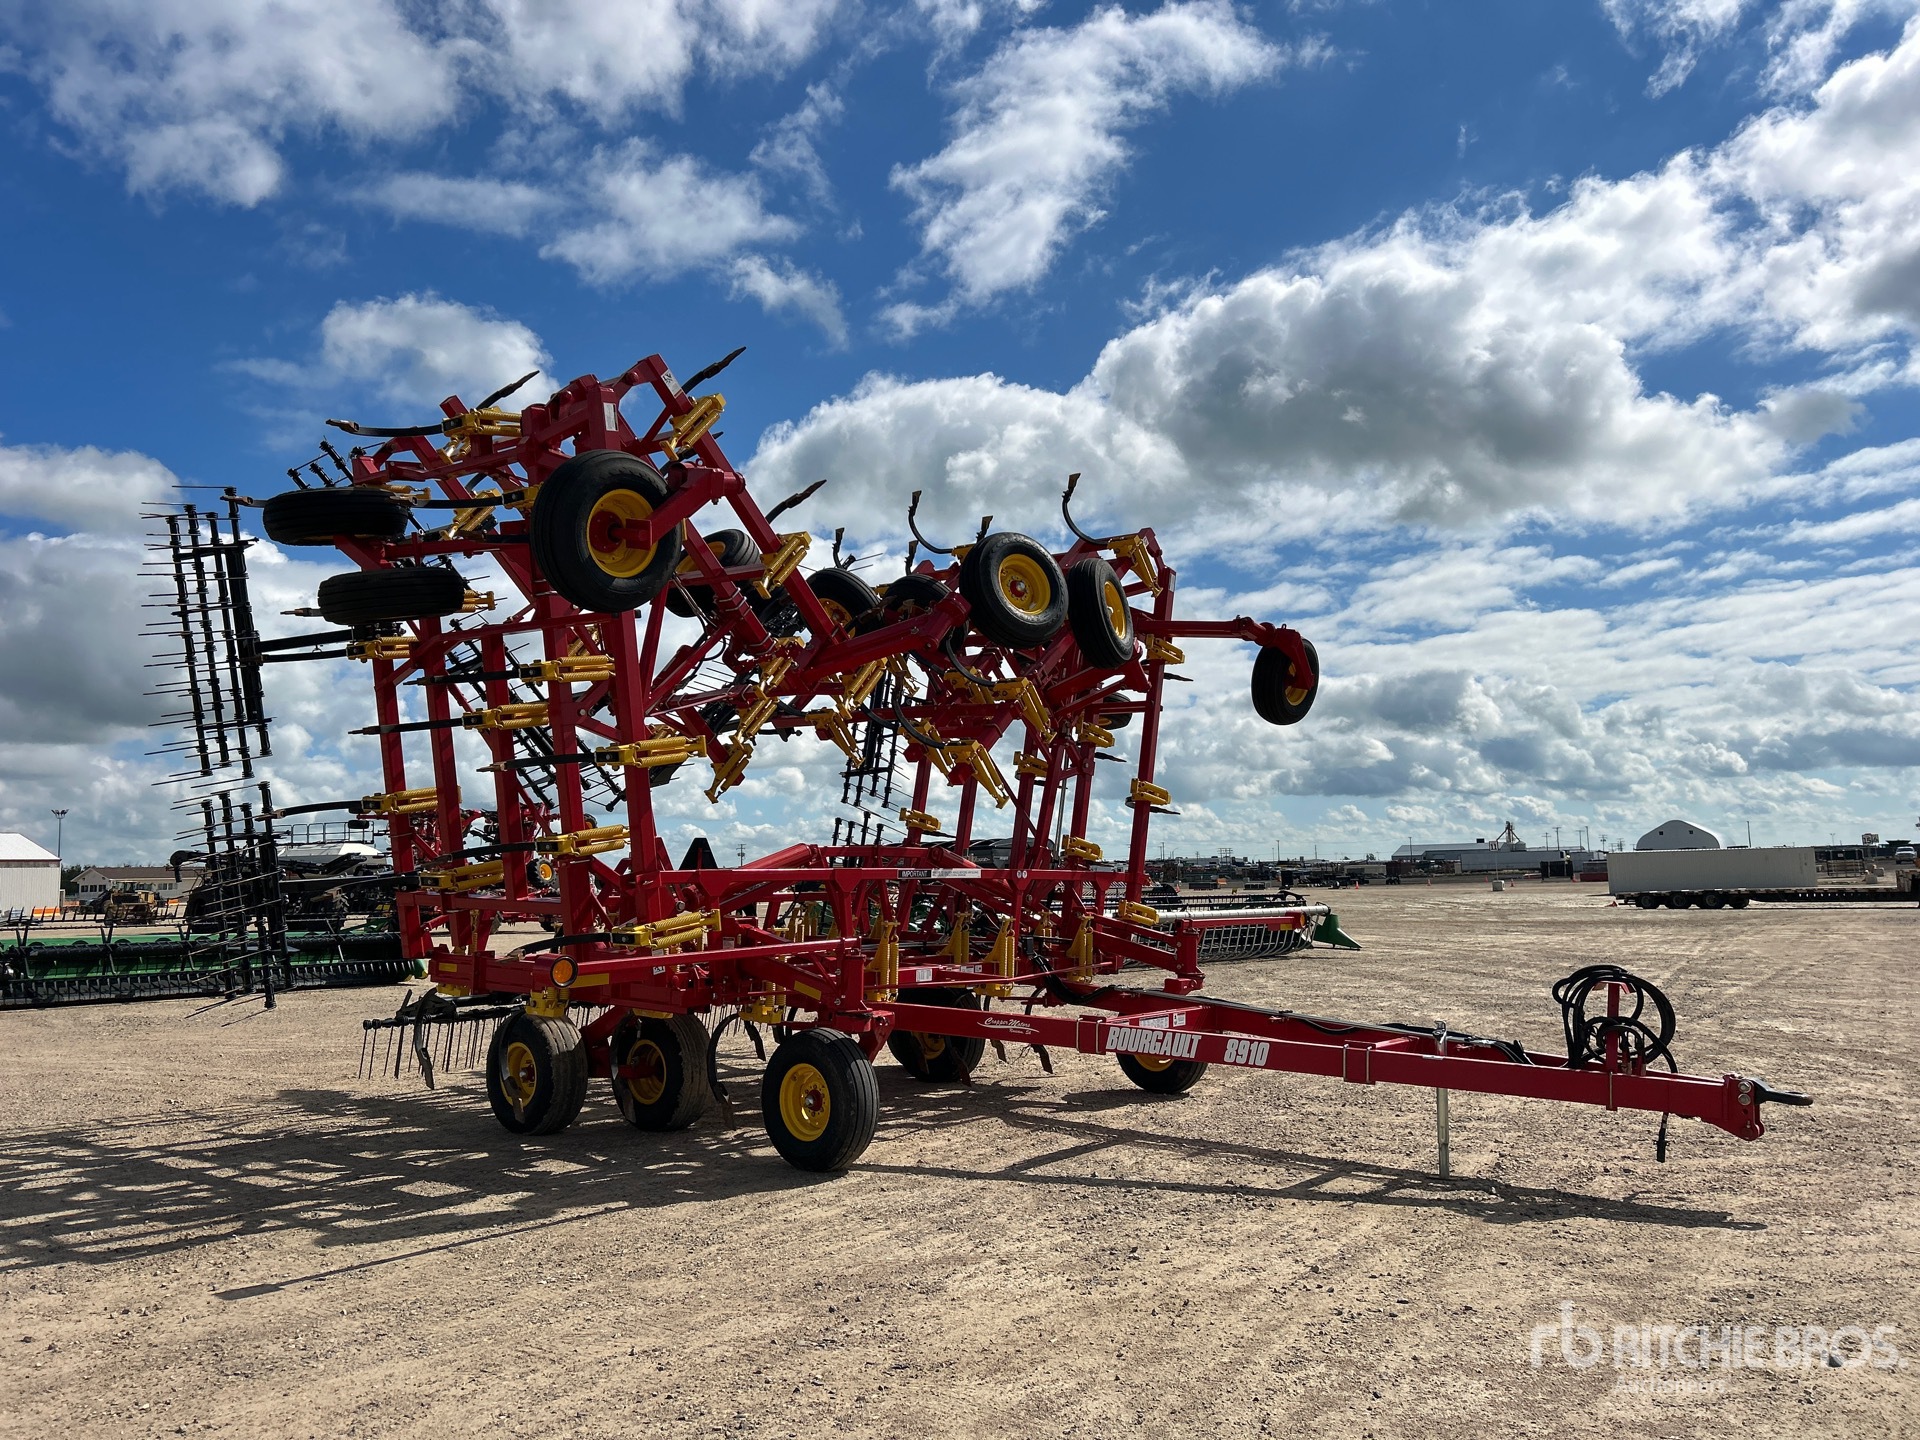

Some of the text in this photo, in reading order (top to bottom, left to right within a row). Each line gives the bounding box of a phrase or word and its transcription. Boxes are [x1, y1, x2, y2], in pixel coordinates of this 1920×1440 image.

[901, 870, 928, 878] IMPORTANT
[1008, 1019, 1031, 1027] Motors
[1105, 1026, 1270, 1067] BOURGAULT 8910
